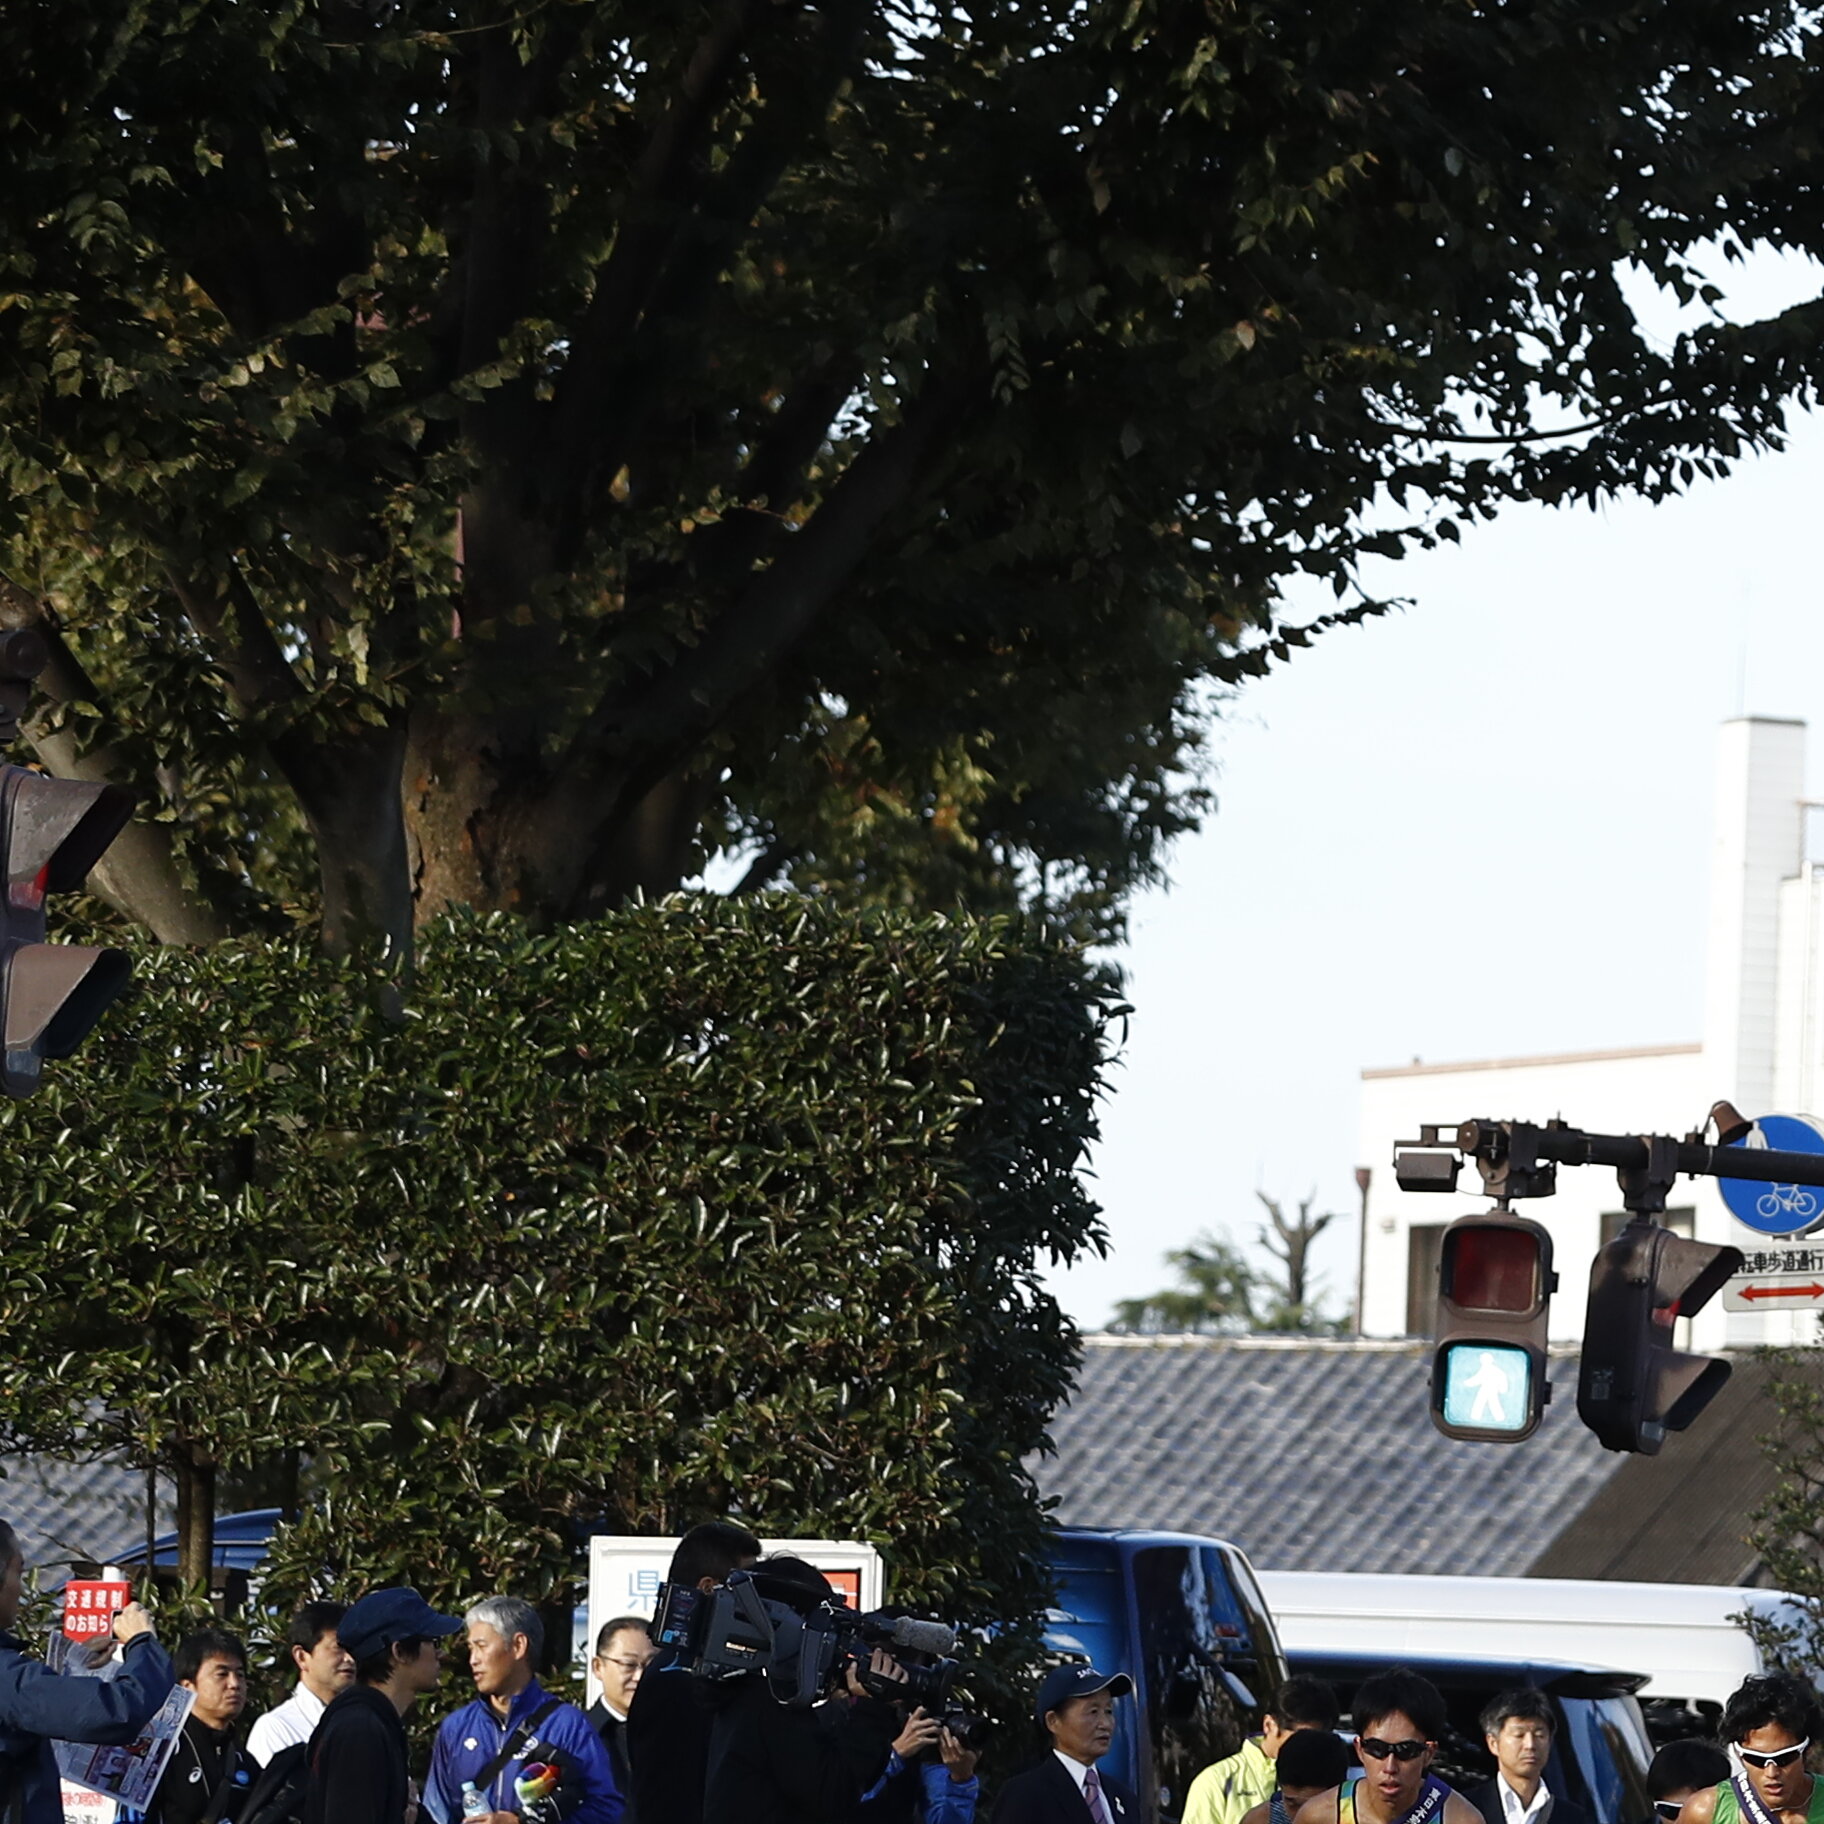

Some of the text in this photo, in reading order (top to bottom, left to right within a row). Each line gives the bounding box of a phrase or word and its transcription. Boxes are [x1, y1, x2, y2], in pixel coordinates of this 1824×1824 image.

[66, 1590, 124, 1609] 交通規制
[628, 1569, 660, 1611] 県
